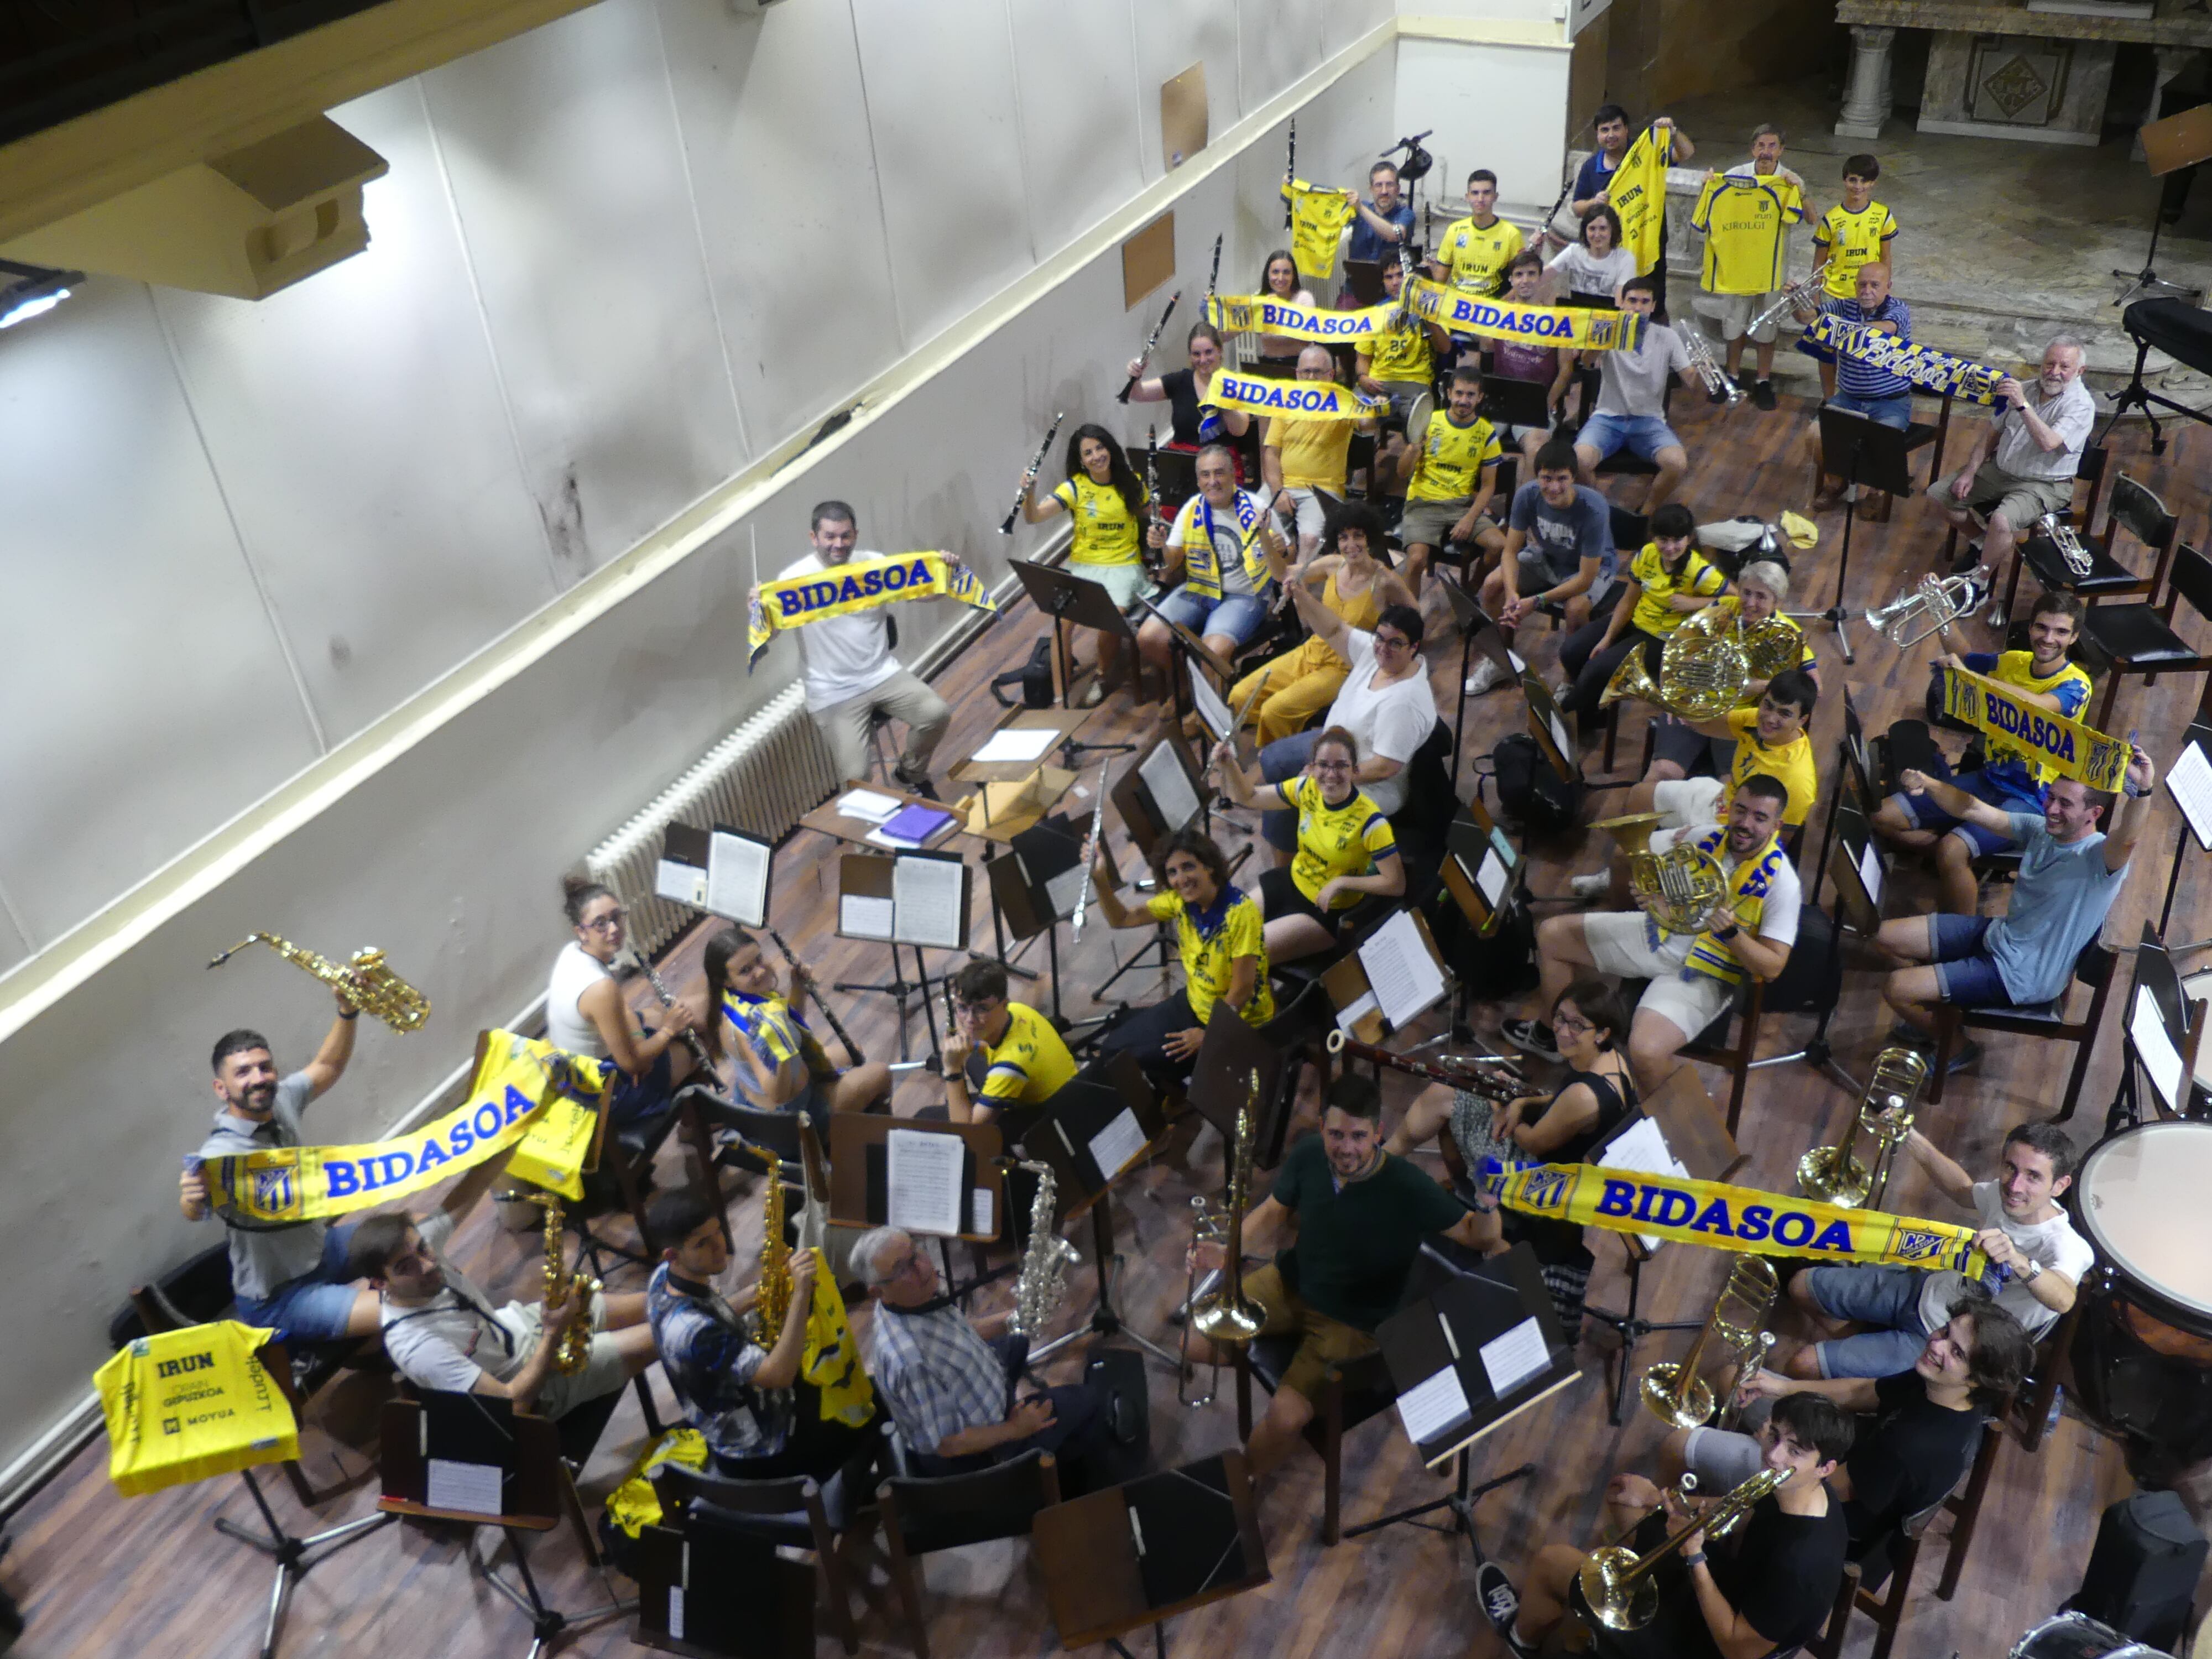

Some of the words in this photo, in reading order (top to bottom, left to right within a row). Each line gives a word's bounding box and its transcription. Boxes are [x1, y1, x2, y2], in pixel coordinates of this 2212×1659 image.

[1617, 184, 1644, 208] IRUN
[1722, 222, 1765, 232] KIROLGI
[1846, 248, 1867, 257] IRUN
[1462, 263, 1489, 274] IRUN
[1262, 304, 1373, 335] BIDASOA
[1452, 299, 1574, 338] BIDASOA
[1220, 377, 1339, 412] BIDASOA
[776, 559, 935, 617] BIDASOA
[1985, 692, 2075, 763] BIDASOA
[323, 1084, 536, 1198] BIDASOA
[1594, 1179, 1855, 1253] BIDASOA
[157, 1352, 215, 1378] IRUN
[187, 1408, 235, 1426] MOYUA
